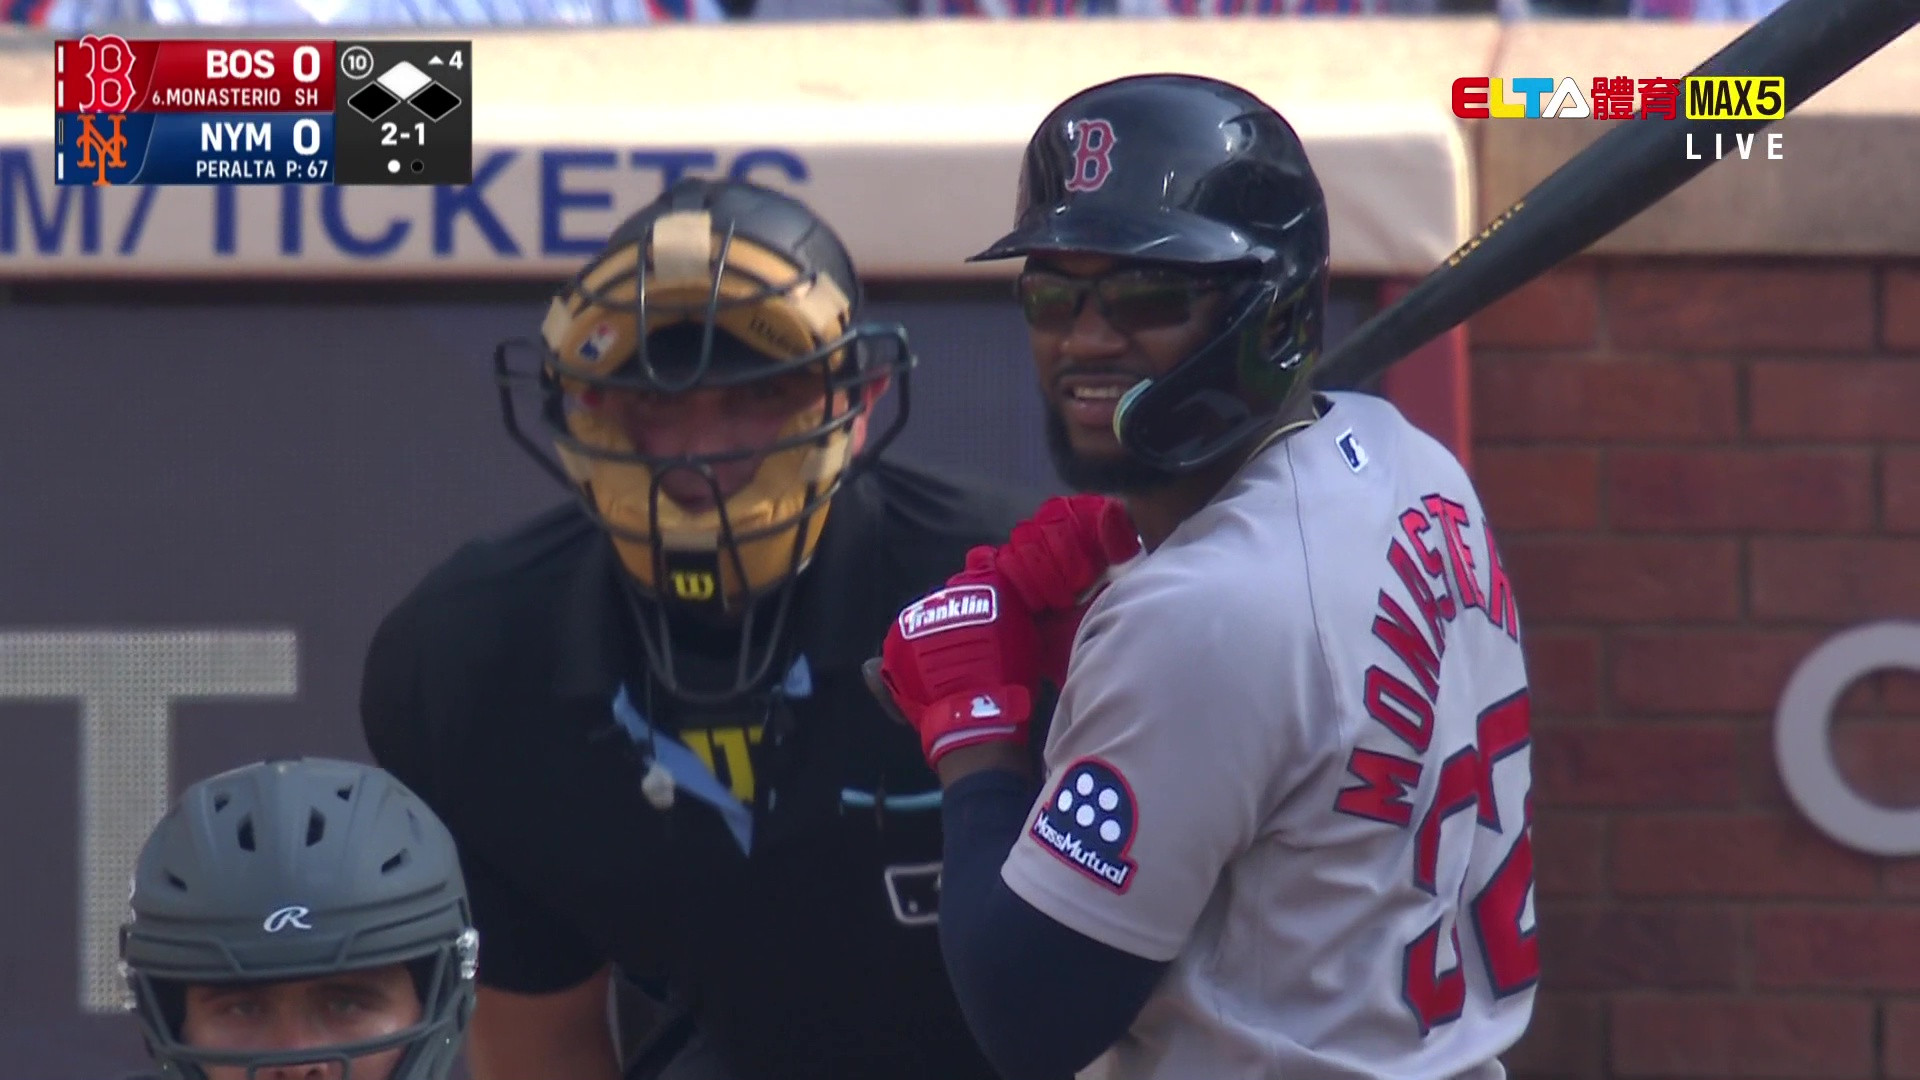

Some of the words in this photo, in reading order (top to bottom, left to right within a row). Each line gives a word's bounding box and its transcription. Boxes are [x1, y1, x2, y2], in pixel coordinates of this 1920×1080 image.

[1065, 118, 1117, 191] B
[904, 594, 990, 634] Franklin
[1034, 810, 1129, 885] MassMutual
